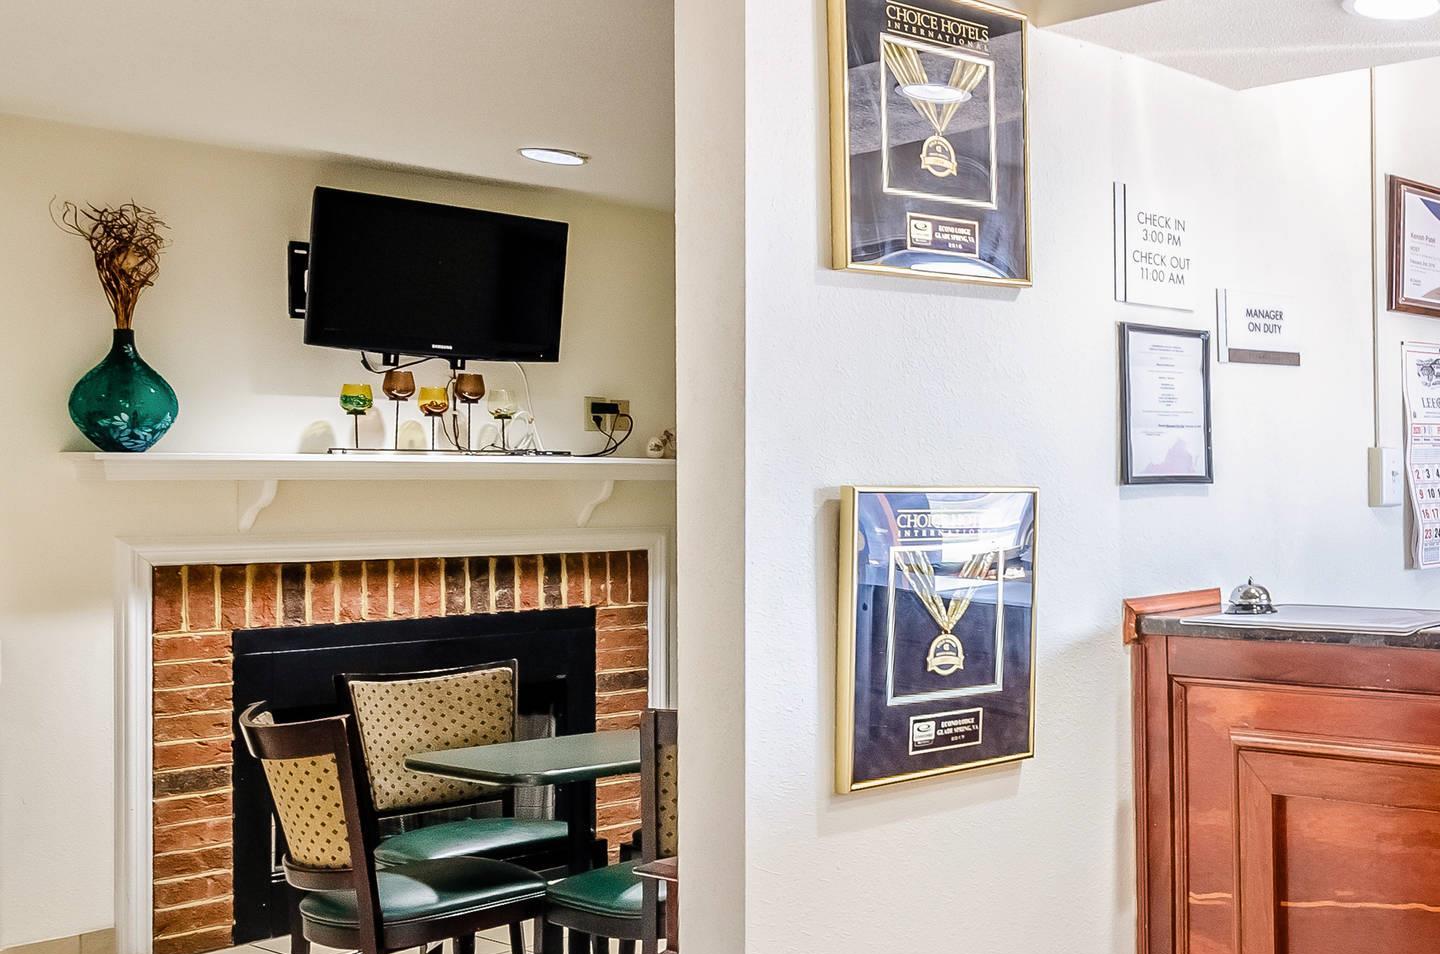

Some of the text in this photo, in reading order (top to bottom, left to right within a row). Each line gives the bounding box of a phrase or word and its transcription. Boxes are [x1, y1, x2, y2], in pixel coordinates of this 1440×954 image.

[886, 5, 989, 43] CHOICE HOTELS
[887, 20, 989, 52] INTERNATIONAL
[1137, 211, 1186, 232] CHECK IN
[1142, 228, 1182, 247] 3:00 PM
[1132, 249, 1191, 271] CHECK OUT
[1140, 267, 1185, 286] 11:00 AM
[1245, 308, 1284, 321] MANAGER
[1248, 321, 1282, 334] ON DUTY
[1415, 469, 1420, 479] 2
[1425, 469, 1431, 479] 3
[1436, 468, 1440, 478] 4
[1419, 489, 1424, 499] 9
[1427, 488, 1435, 498] 10
[1431, 508, 1439, 518] 17
[1424, 528, 1432, 539] 23
